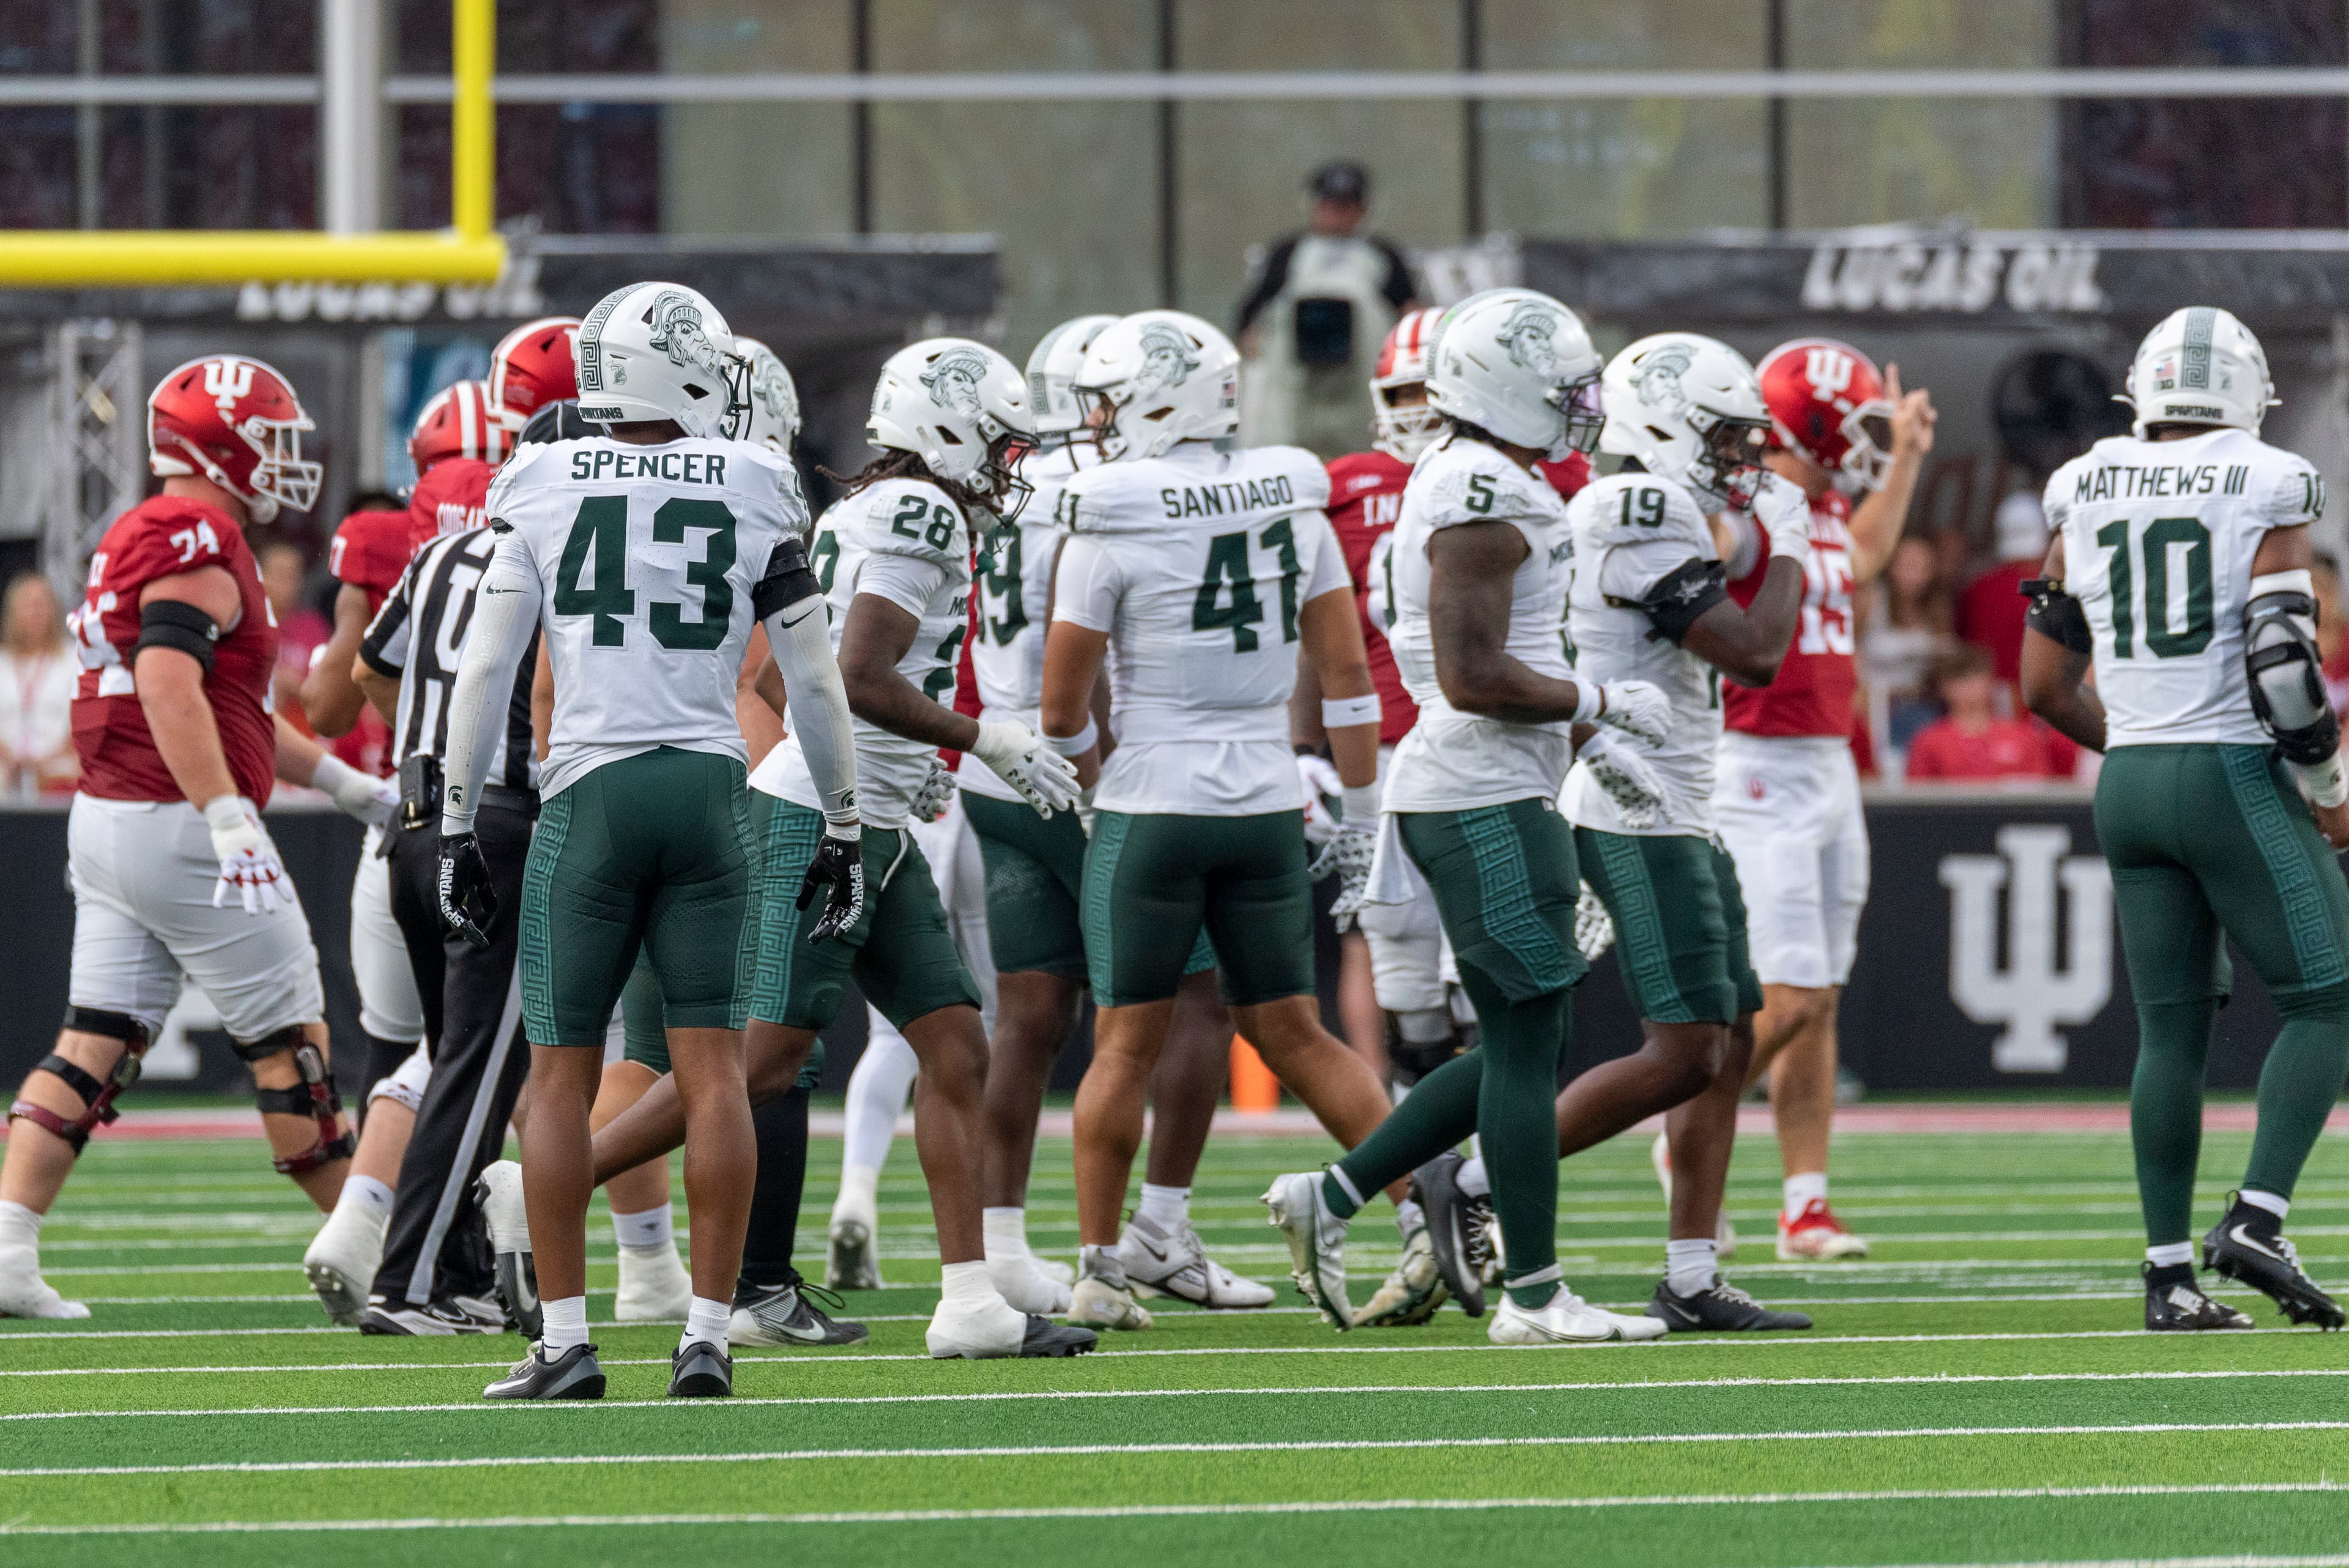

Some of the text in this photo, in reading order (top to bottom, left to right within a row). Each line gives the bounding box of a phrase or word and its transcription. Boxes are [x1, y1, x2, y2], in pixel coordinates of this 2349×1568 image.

[571, 450, 725, 485] SPENCER
[2075, 466, 2249, 503] MATTHEWS III
[1161, 475, 1293, 518] SANTIAGO
[1466, 473, 1497, 514] 5
[1618, 486, 1665, 529] 19
[169, 519, 220, 564] 74
[891, 494, 956, 551] 28
[554, 496, 738, 652] 43
[1193, 518, 1301, 653] 41
[2097, 517, 2214, 659] 10
[1798, 551, 1855, 654] 15
